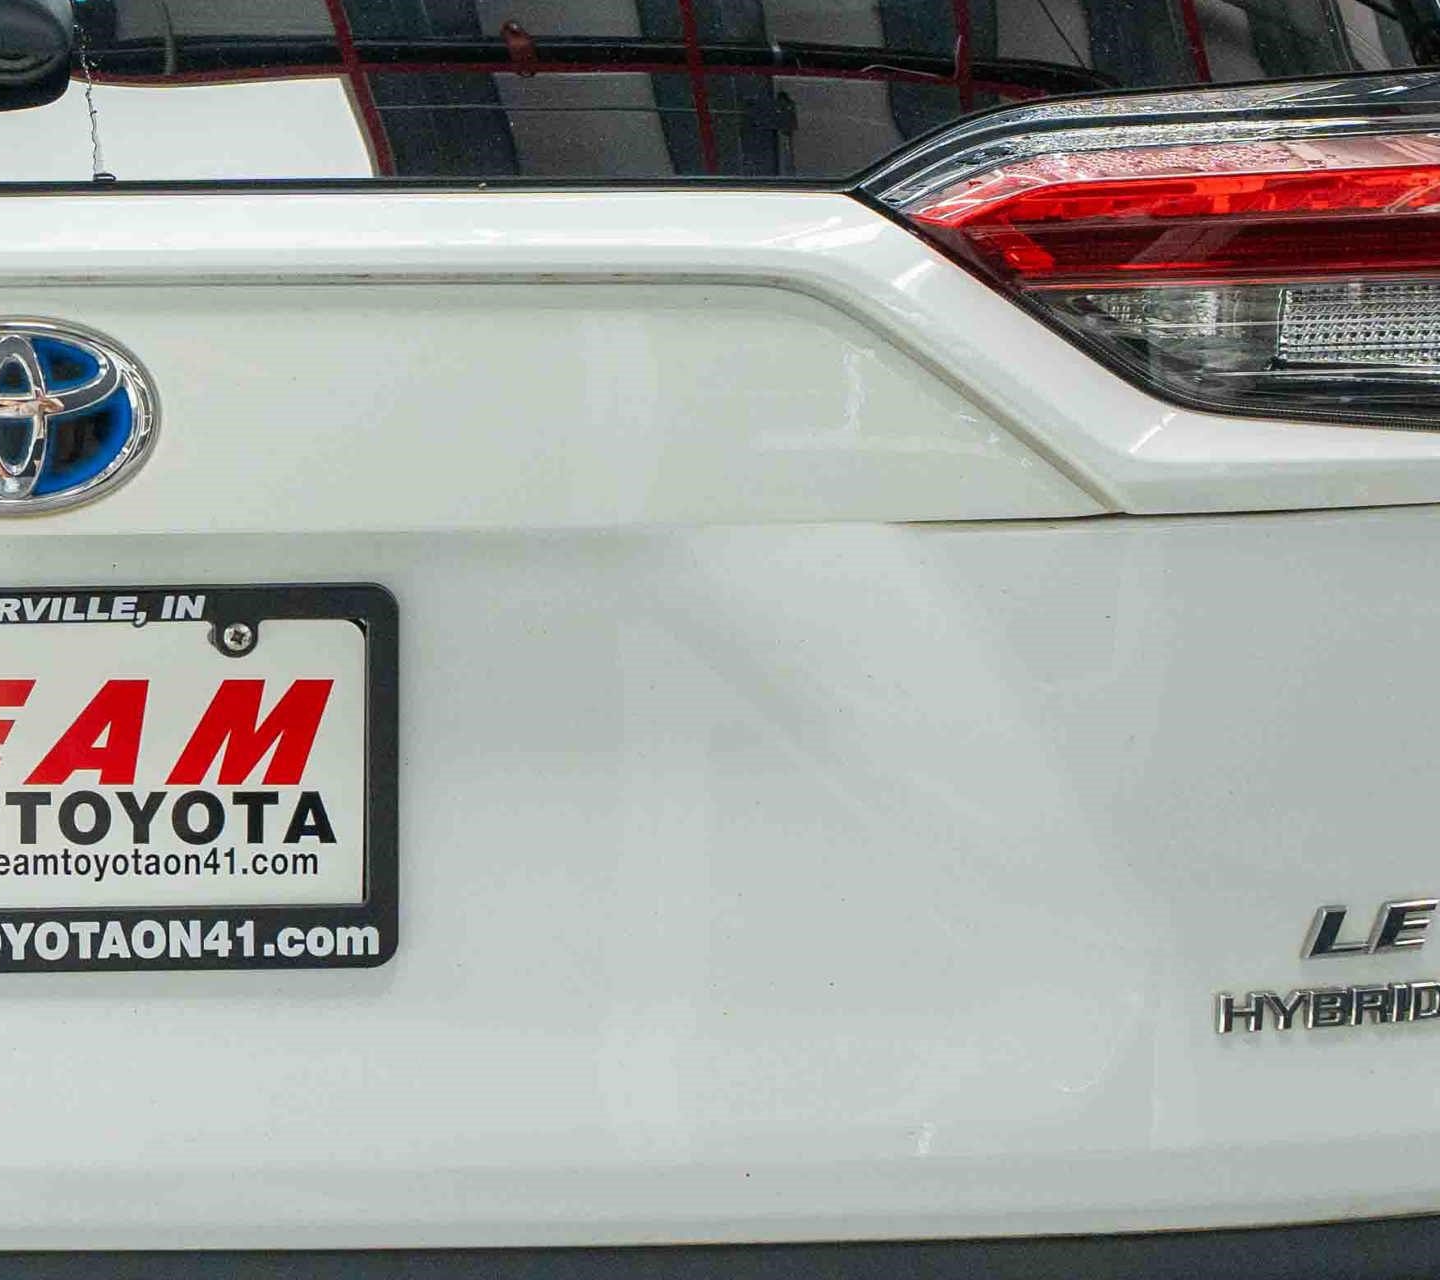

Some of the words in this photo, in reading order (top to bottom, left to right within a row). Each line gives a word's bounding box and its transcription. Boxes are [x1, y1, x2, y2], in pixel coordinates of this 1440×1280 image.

[160, 594, 206, 619] IN
[5, 790, 337, 845] TOYOTA
[1301, 897, 1440, 960] LE
